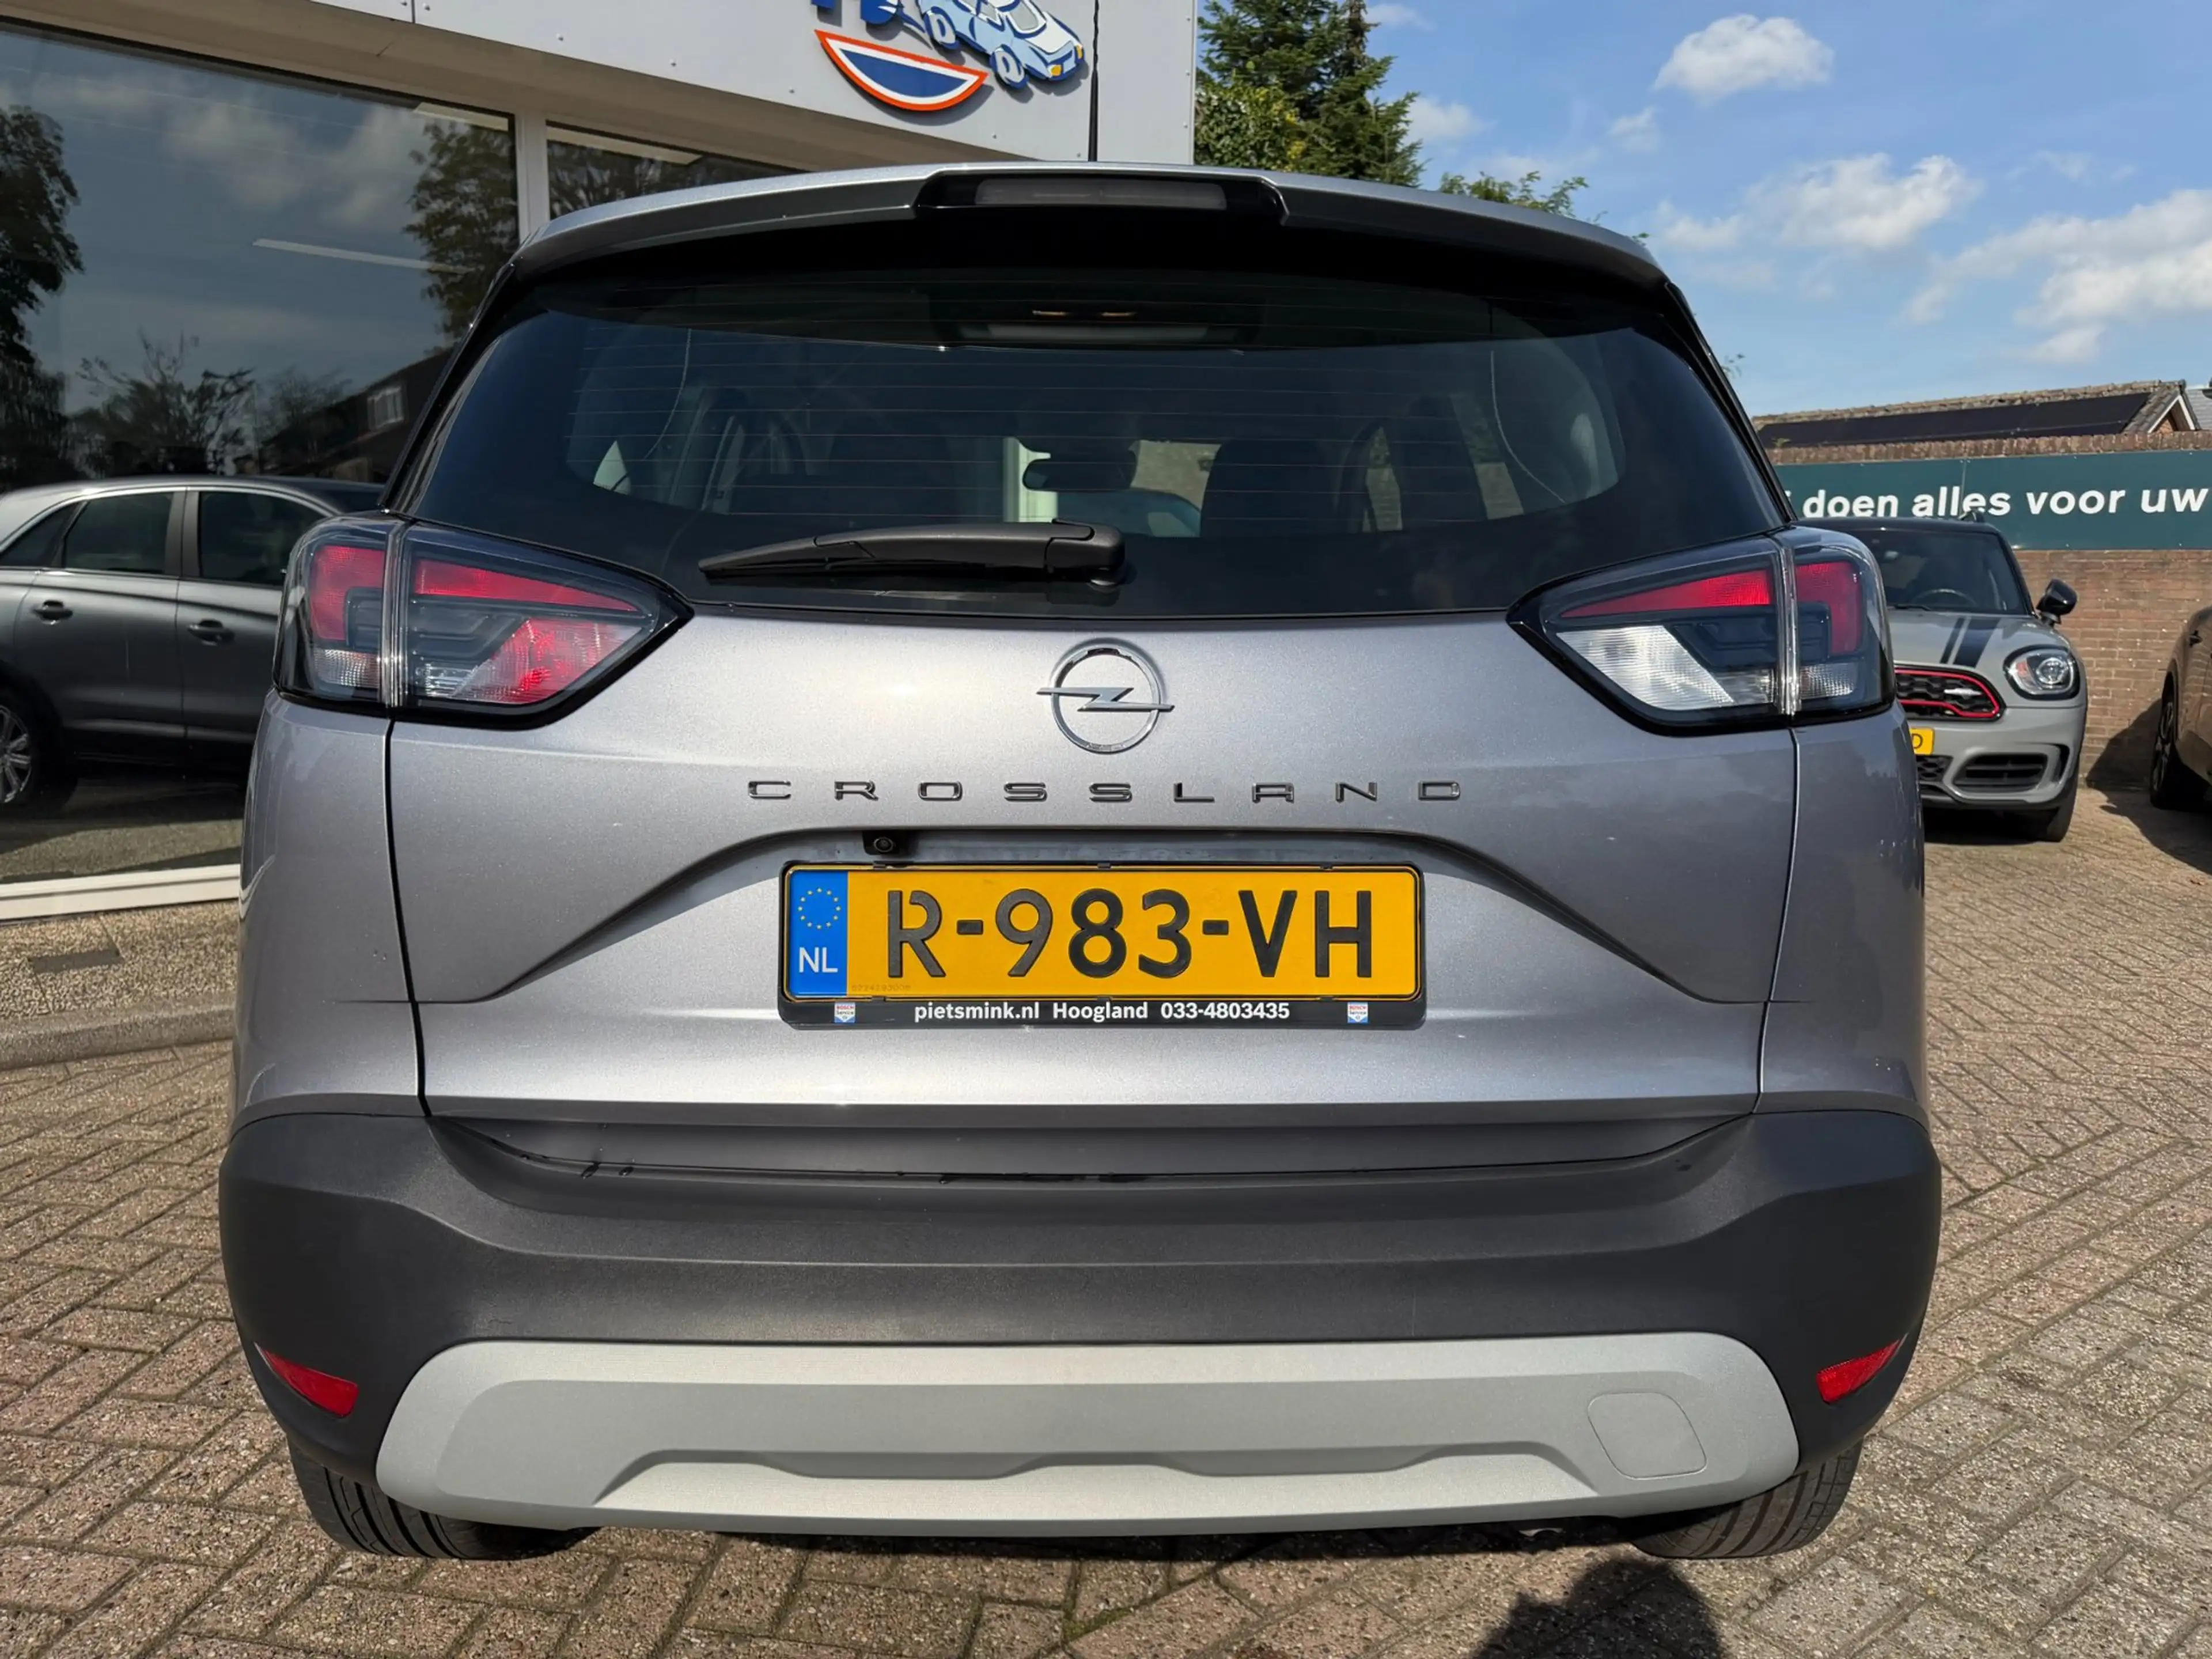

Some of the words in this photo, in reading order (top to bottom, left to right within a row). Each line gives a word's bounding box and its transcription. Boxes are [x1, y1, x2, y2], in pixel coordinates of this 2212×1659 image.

[1802, 489, 1899, 518] doen
[1912, 486, 2011, 517] alles
[2026, 489, 2126, 514] voor
[2141, 487, 2209, 513] uw
[748, 781, 1461, 802] CROSSLAND
[887, 888, 1372, 979] R-983-VH
[798, 946, 839, 974] NL
[915, 1002, 1040, 1023] pietsmink.nl
[1052, 1002, 1148, 1023] Hoogland
[1161, 1002, 1290, 1019] 033-4803435
